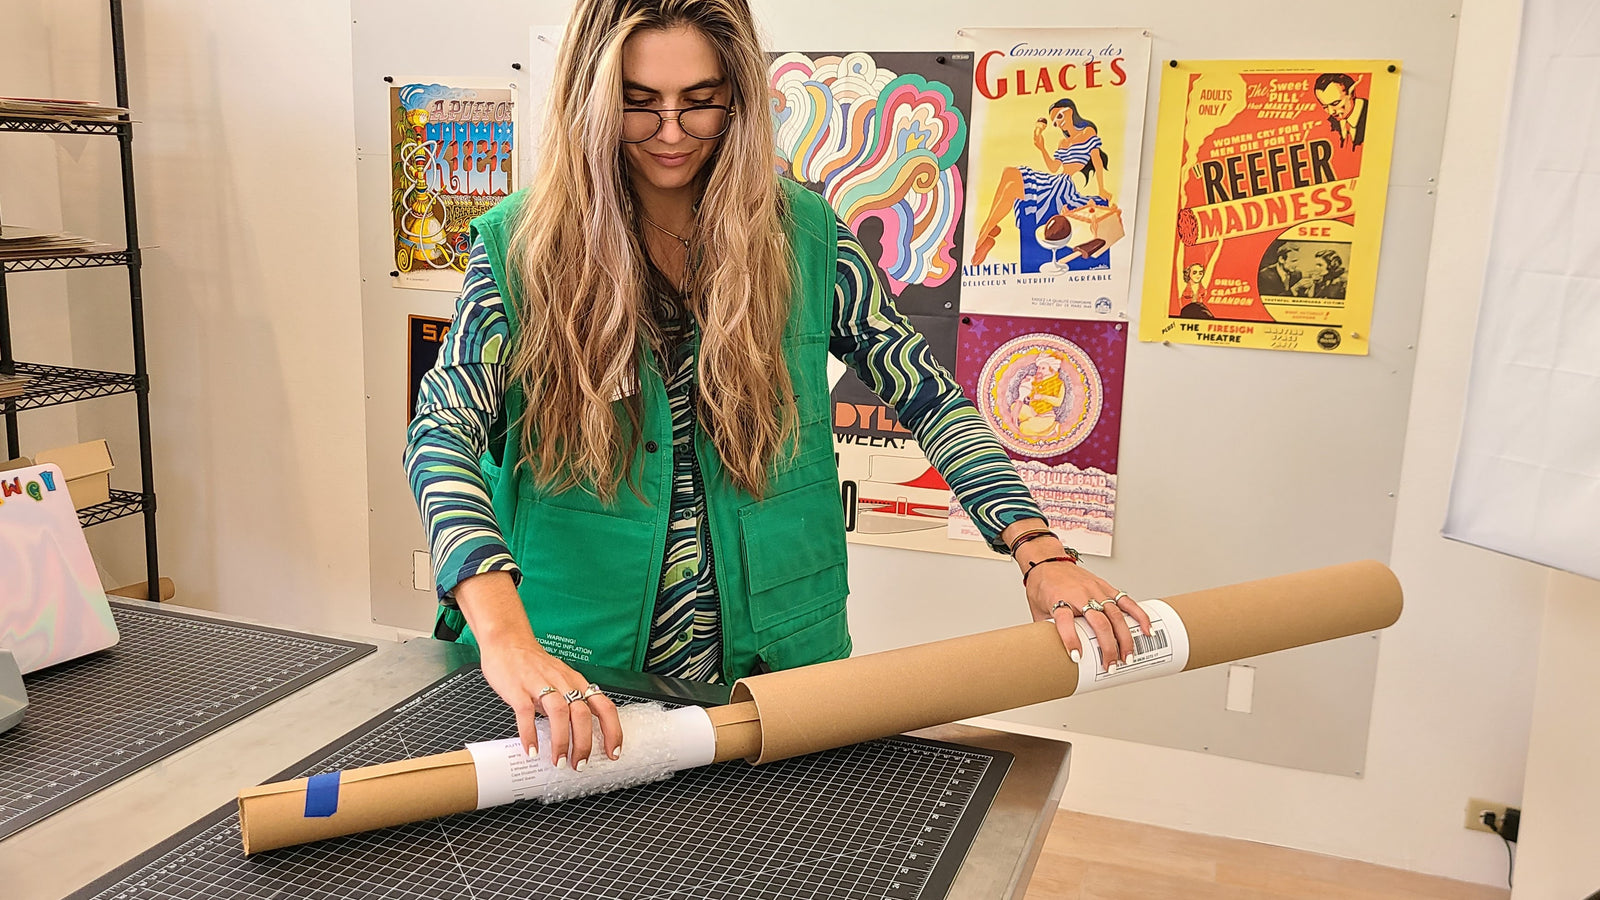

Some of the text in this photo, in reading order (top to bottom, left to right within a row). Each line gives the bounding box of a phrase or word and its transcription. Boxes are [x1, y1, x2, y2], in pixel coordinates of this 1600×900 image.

[1010, 42, 1122, 66] Consommez des
[974, 50, 1127, 100] GLACES
[1200, 89, 1232, 101] ADULTS
[1248, 83, 1269, 98] The
[430, 100, 450, 122] A
[450, 100, 494, 122] PUFF
[1198, 104, 1227, 116] ONLY!
[1294, 103, 1317, 112] LIFE
[1213, 134, 1253, 148] WOMEN
[1256, 128, 1276, 139] CRY
[1278, 124, 1299, 135] FOR
[1210, 146, 1235, 158] MEN
[1240, 141, 1260, 152] DIE
[1264, 136, 1286, 148] FOR
[1298, 226, 1332, 238] SEE
[962, 262, 1018, 276] ALIMENT
[1210, 286, 1250, 296] CRAZED
[1208, 296, 1254, 306] ABANDON
[1180, 324, 1200, 332] THE
[1196, 332, 1242, 343] THEATRE
[1039, 472, 1076, 486] BLUES
[1076, 474, 1106, 487] BAND
[546, 633, 576, 644] WARNING!
[536, 638, 592, 655] TOMATIC INFLATION
